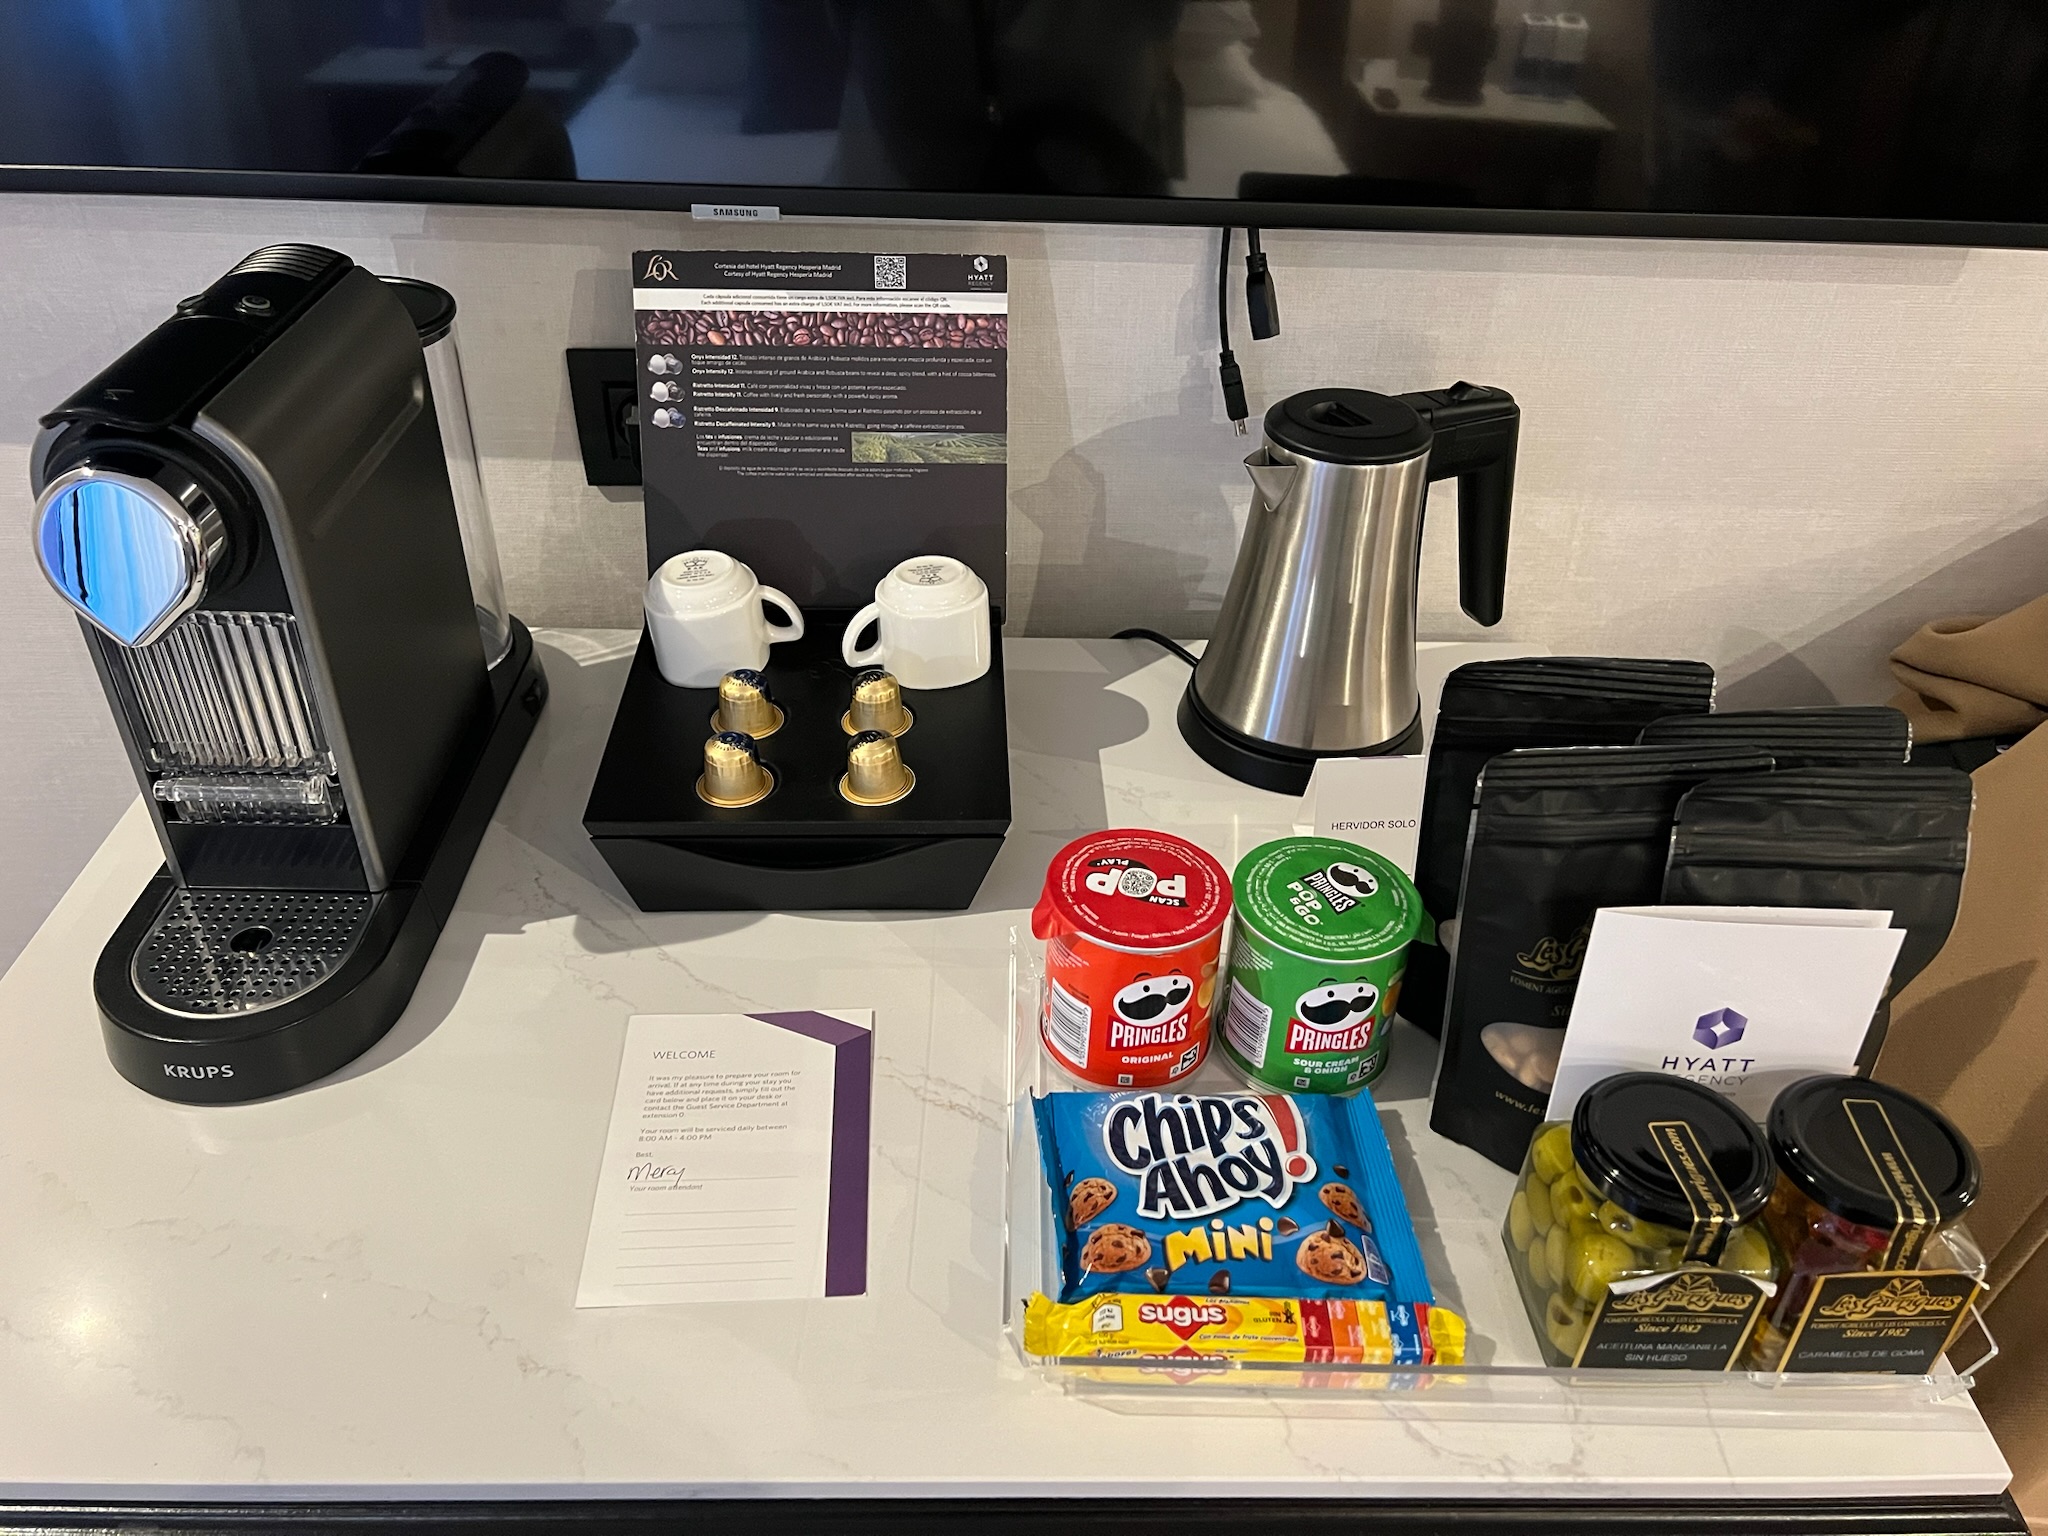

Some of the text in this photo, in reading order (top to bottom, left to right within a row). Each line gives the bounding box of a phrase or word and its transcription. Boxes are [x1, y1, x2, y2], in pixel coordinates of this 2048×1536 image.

[713, 208, 758, 217] SAMSUNG
[760, 264, 774, 272] Hyatt
[776, 264, 797, 272] Regency
[1331, 819, 1417, 831] HERVIDOR SOLO
[1097, 858, 1130, 867] PLAY
[1086, 867, 1186, 898] POP
[1286, 881, 1322, 910] POP
[1303, 871, 1356, 911] PRINGLES
[1149, 895, 1180, 906] SCAN
[1110, 1013, 1189, 1048] PRINGLES
[1289, 1021, 1372, 1051] PRINGLES
[653, 1050, 716, 1060] WELCOME
[1121, 1052, 1174, 1064] ORIGINAL
[1293, 1056, 1360, 1068] SOUR CREAM
[1661, 1056, 1755, 1072] HYATT
[163, 1064, 235, 1080] KRUPS
[1304, 1065, 1348, 1074] & ONION
[1674, 1074, 1750, 1086] GENCY
[709, 1102, 735, 1110] Service
[736, 1101, 779, 1109] Department
[1107, 1094, 1266, 1171] Chips
[1142, 1095, 1308, 1212] Ahoy!
[1820, 1294, 1962, 1320] Les Garrigues
[1140, 1304, 1226, 1327] sugus
[1634, 1324, 1702, 1333] Since 1982
[1842, 1328, 1910, 1338] Since 1982
[1596, 1342, 1727, 1350] ACEITUNA MANZANILLA
[1624, 1354, 1688, 1362] SIN HUESO
[1798, 1349, 1925, 1359] CARAMELOS DE GOMA
